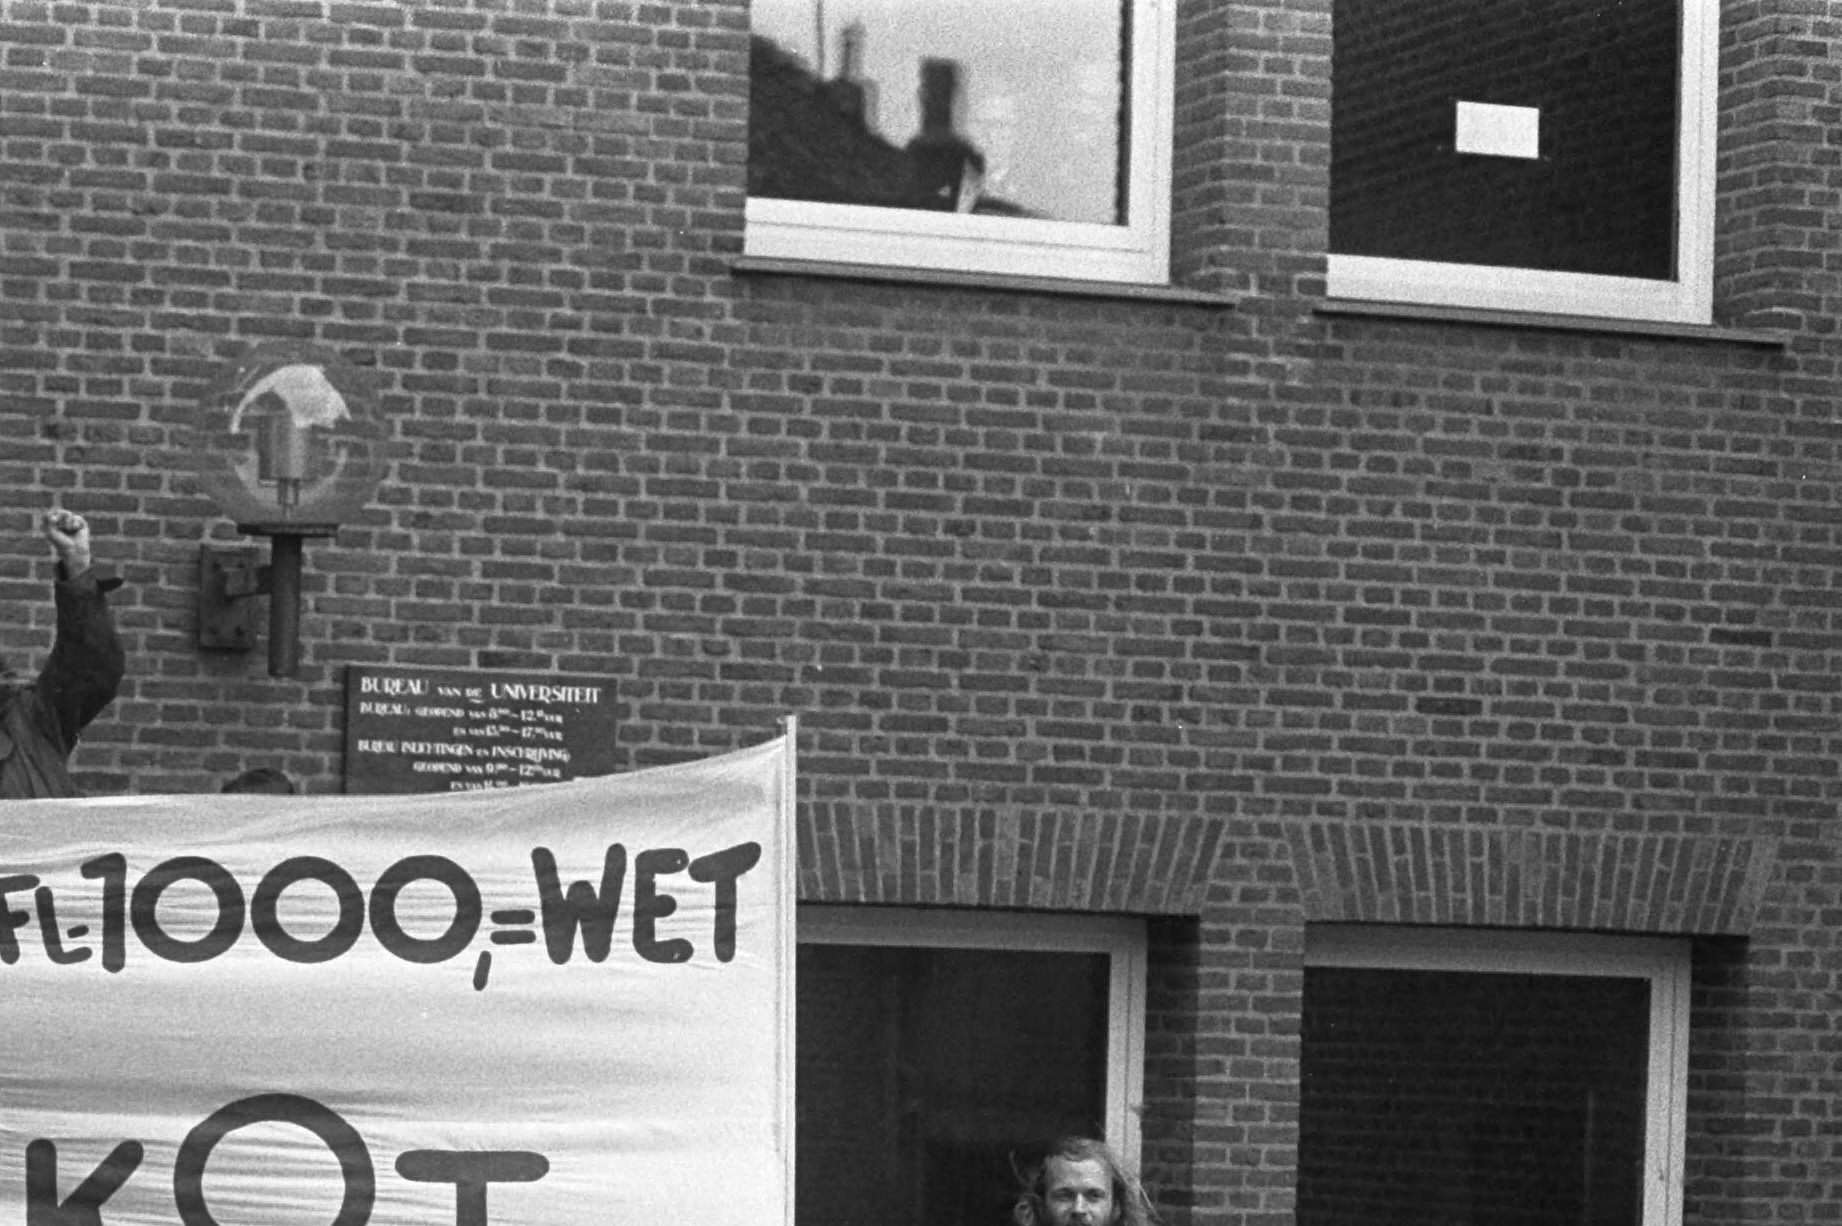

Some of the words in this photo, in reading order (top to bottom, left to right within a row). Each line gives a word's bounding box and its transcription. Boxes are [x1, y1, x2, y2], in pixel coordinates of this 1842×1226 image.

[361, 676, 428, 696] BUREAU
[437, 686, 461, 696] VAN
[465, 687, 481, 697] DE
[491, 682, 601, 704] UNIVERSITEIT
